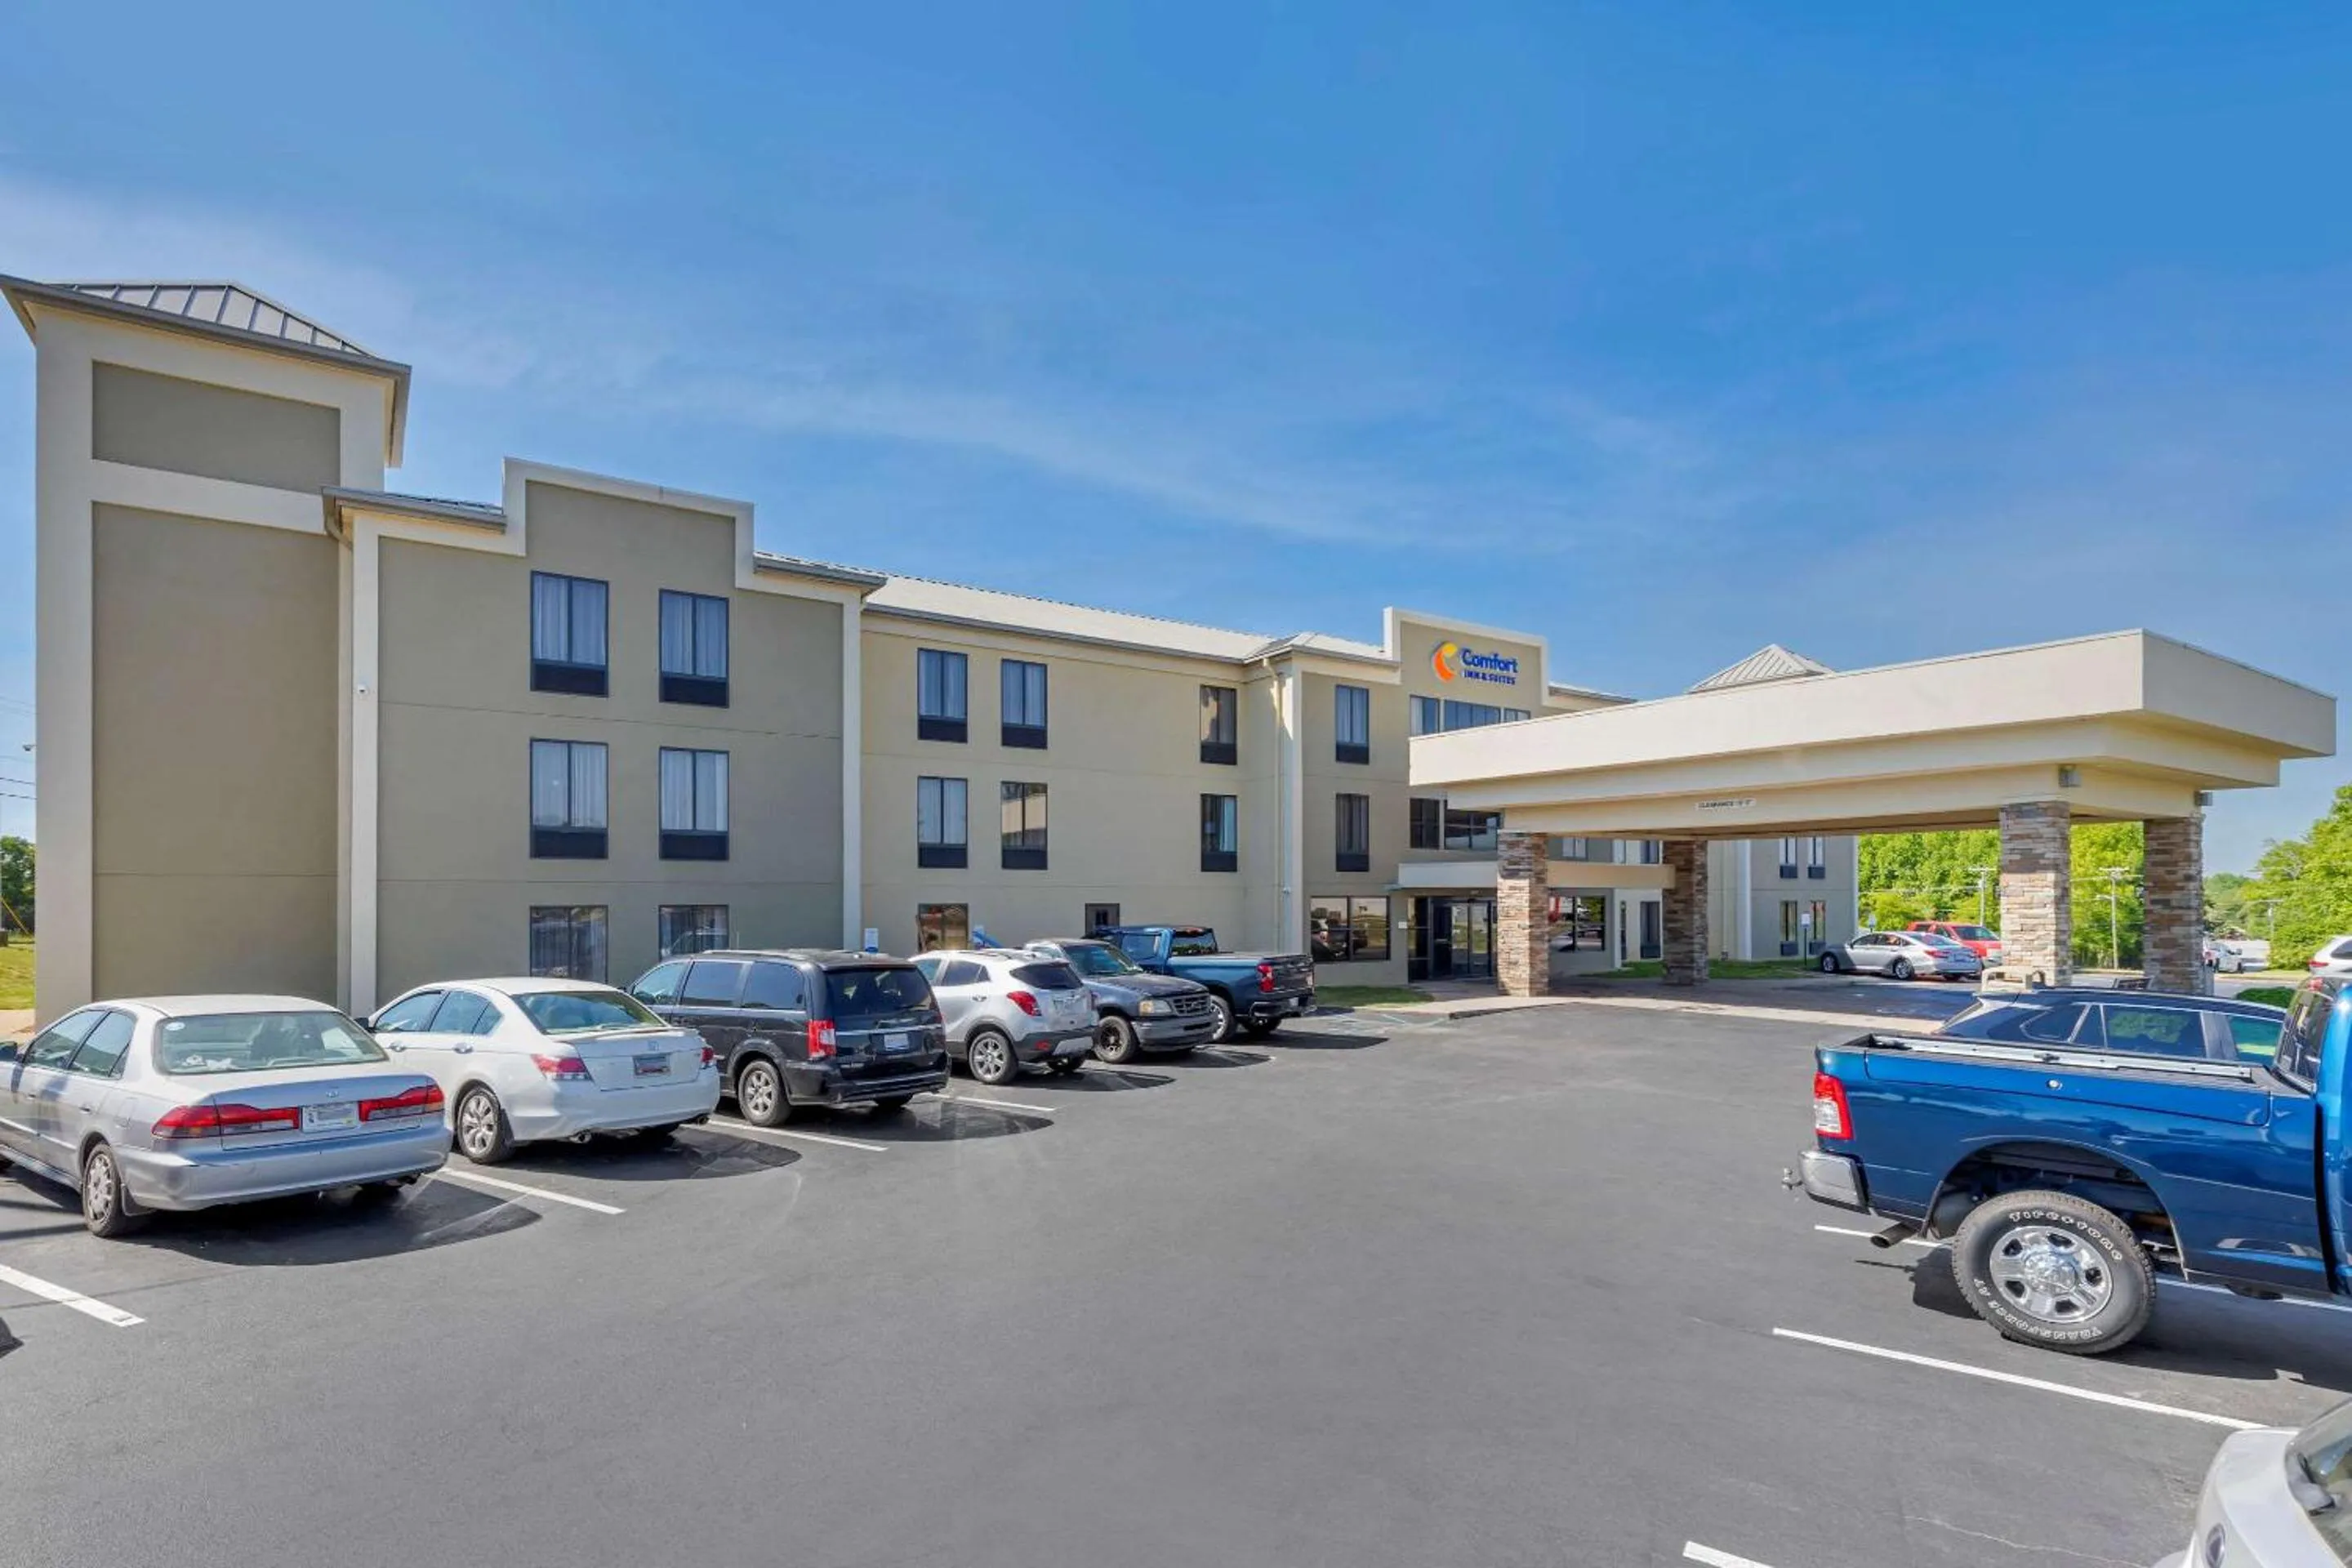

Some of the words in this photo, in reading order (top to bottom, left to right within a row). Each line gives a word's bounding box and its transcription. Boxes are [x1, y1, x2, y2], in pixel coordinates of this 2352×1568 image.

[1460, 648, 1518, 673] Comfort
[1463, 670, 1480, 680] INN
[1481, 672, 1489, 681] &
[1489, 674, 1517, 684] SUITES
